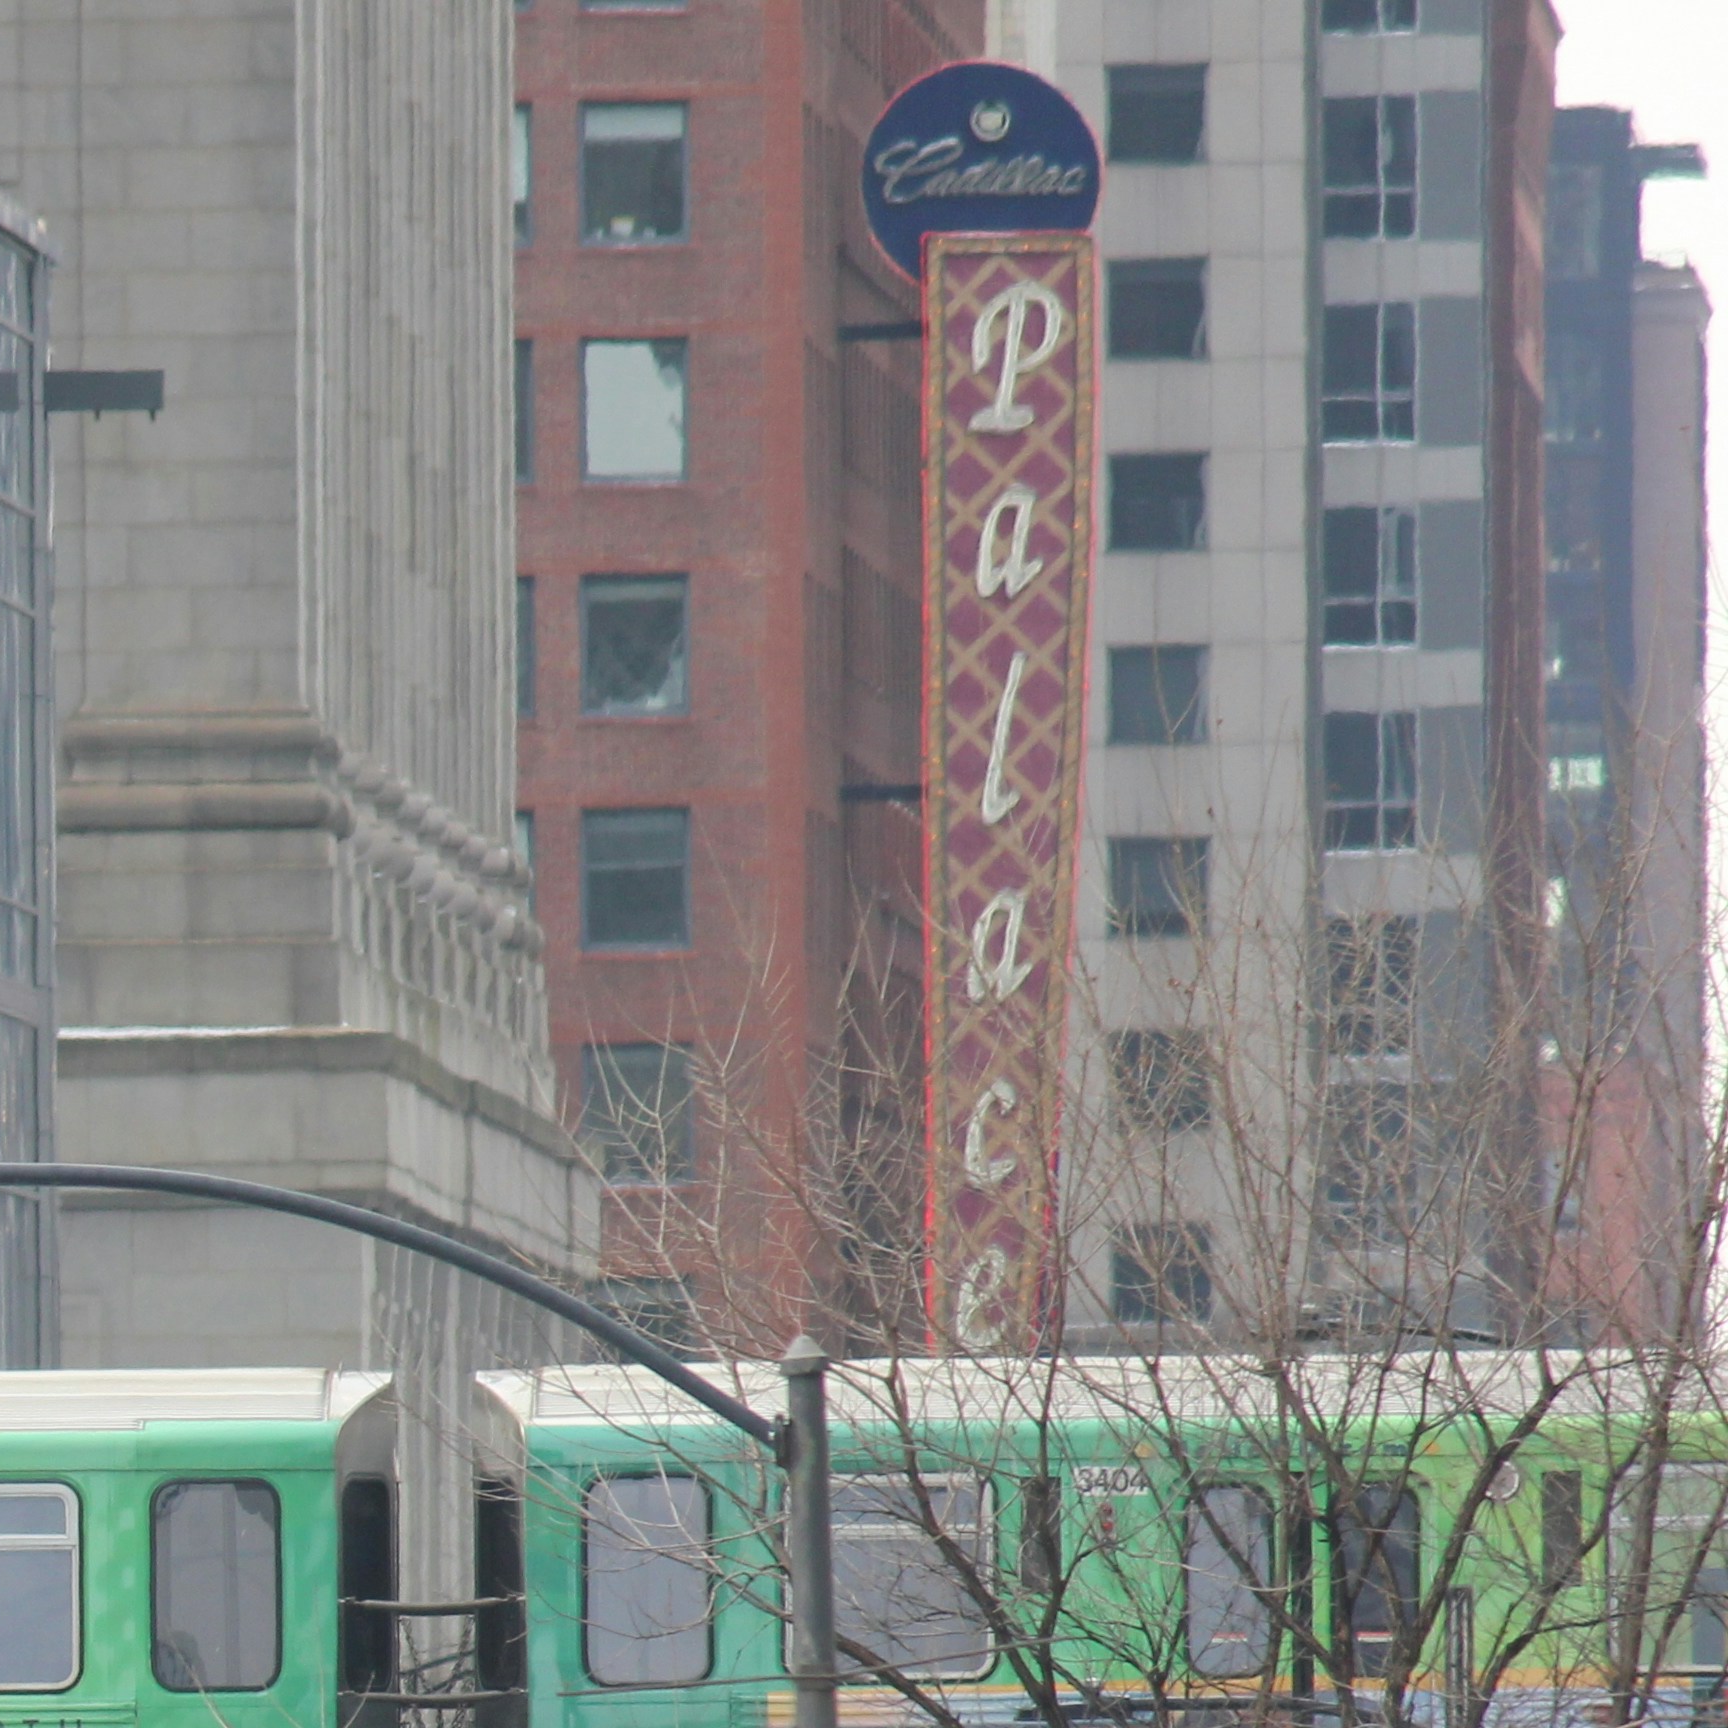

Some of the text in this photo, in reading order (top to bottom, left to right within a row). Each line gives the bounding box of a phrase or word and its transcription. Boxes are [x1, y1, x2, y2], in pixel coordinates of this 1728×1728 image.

[874, 137, 1088, 204] Cadillac
[954, 280, 1065, 1348] Palace
[1076, 1467, 1148, 1493] 3404
